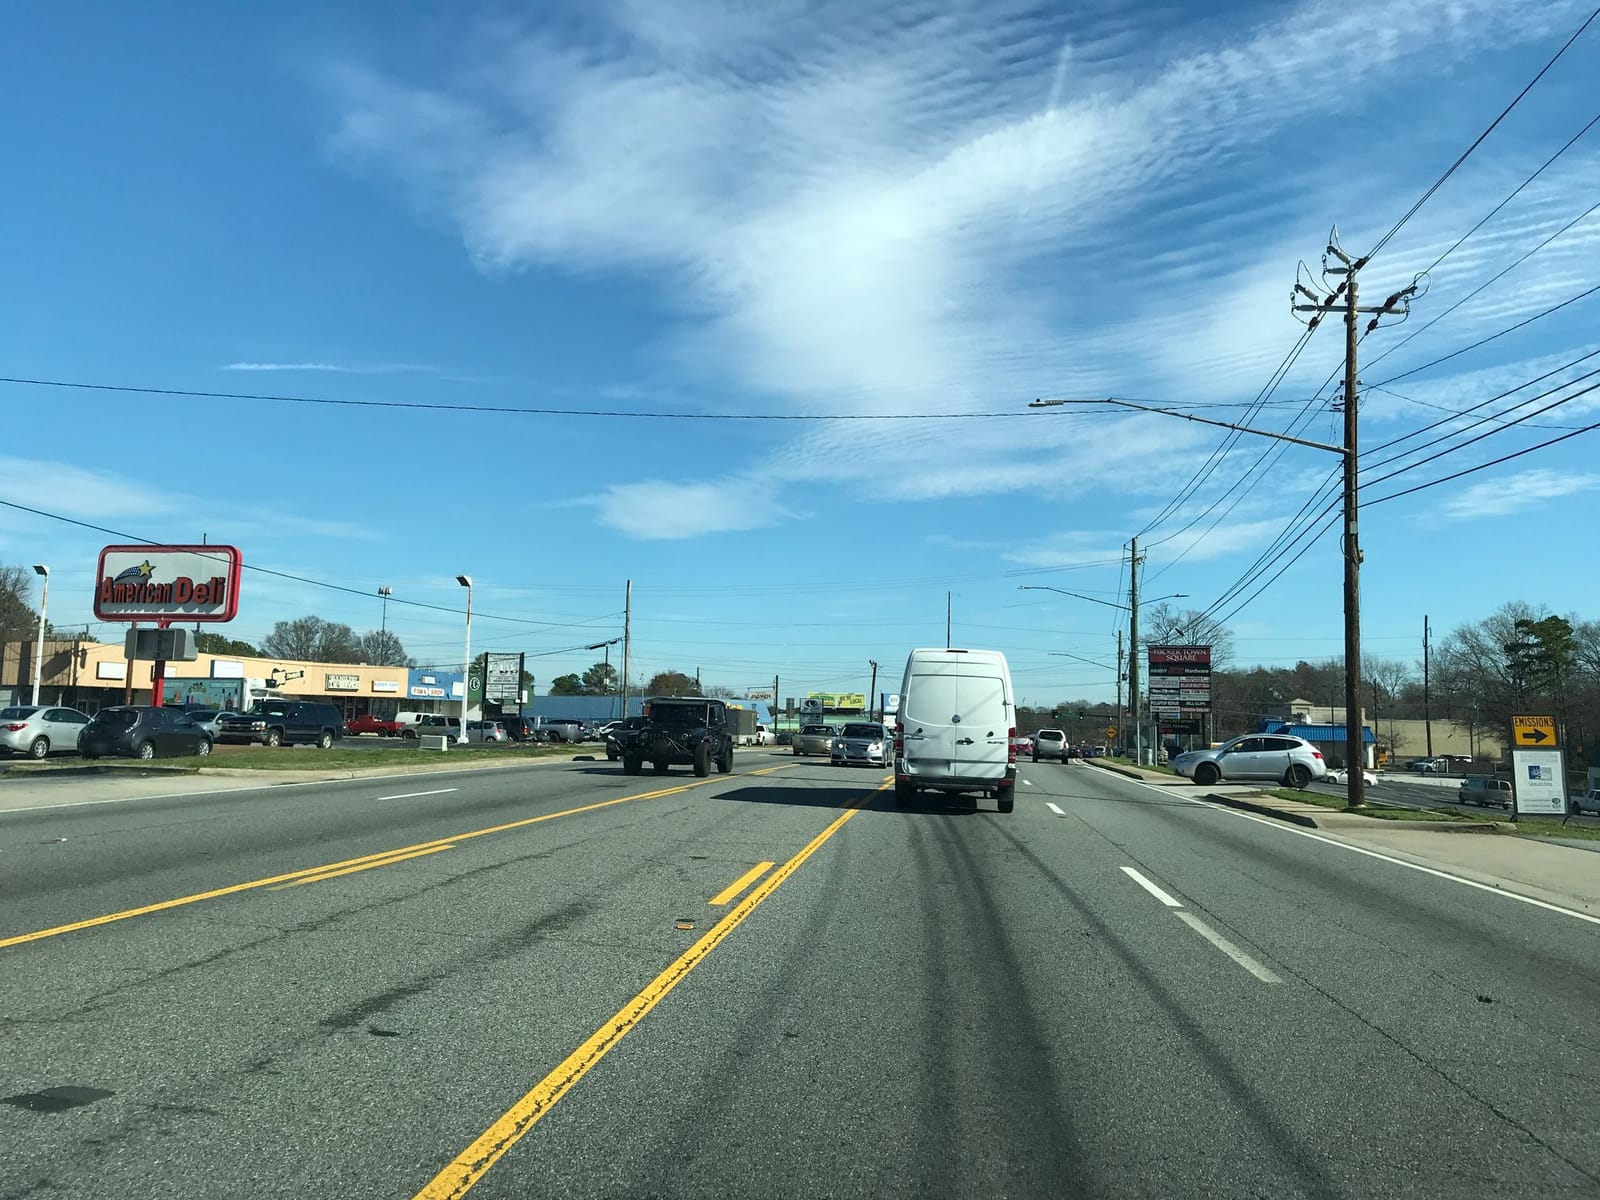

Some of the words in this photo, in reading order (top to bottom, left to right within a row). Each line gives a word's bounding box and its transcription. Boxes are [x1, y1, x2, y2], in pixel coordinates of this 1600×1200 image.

[101, 577, 172, 603] American
[175, 577, 226, 604] Deli
[1514, 717, 1554, 728] EMISSIONS
